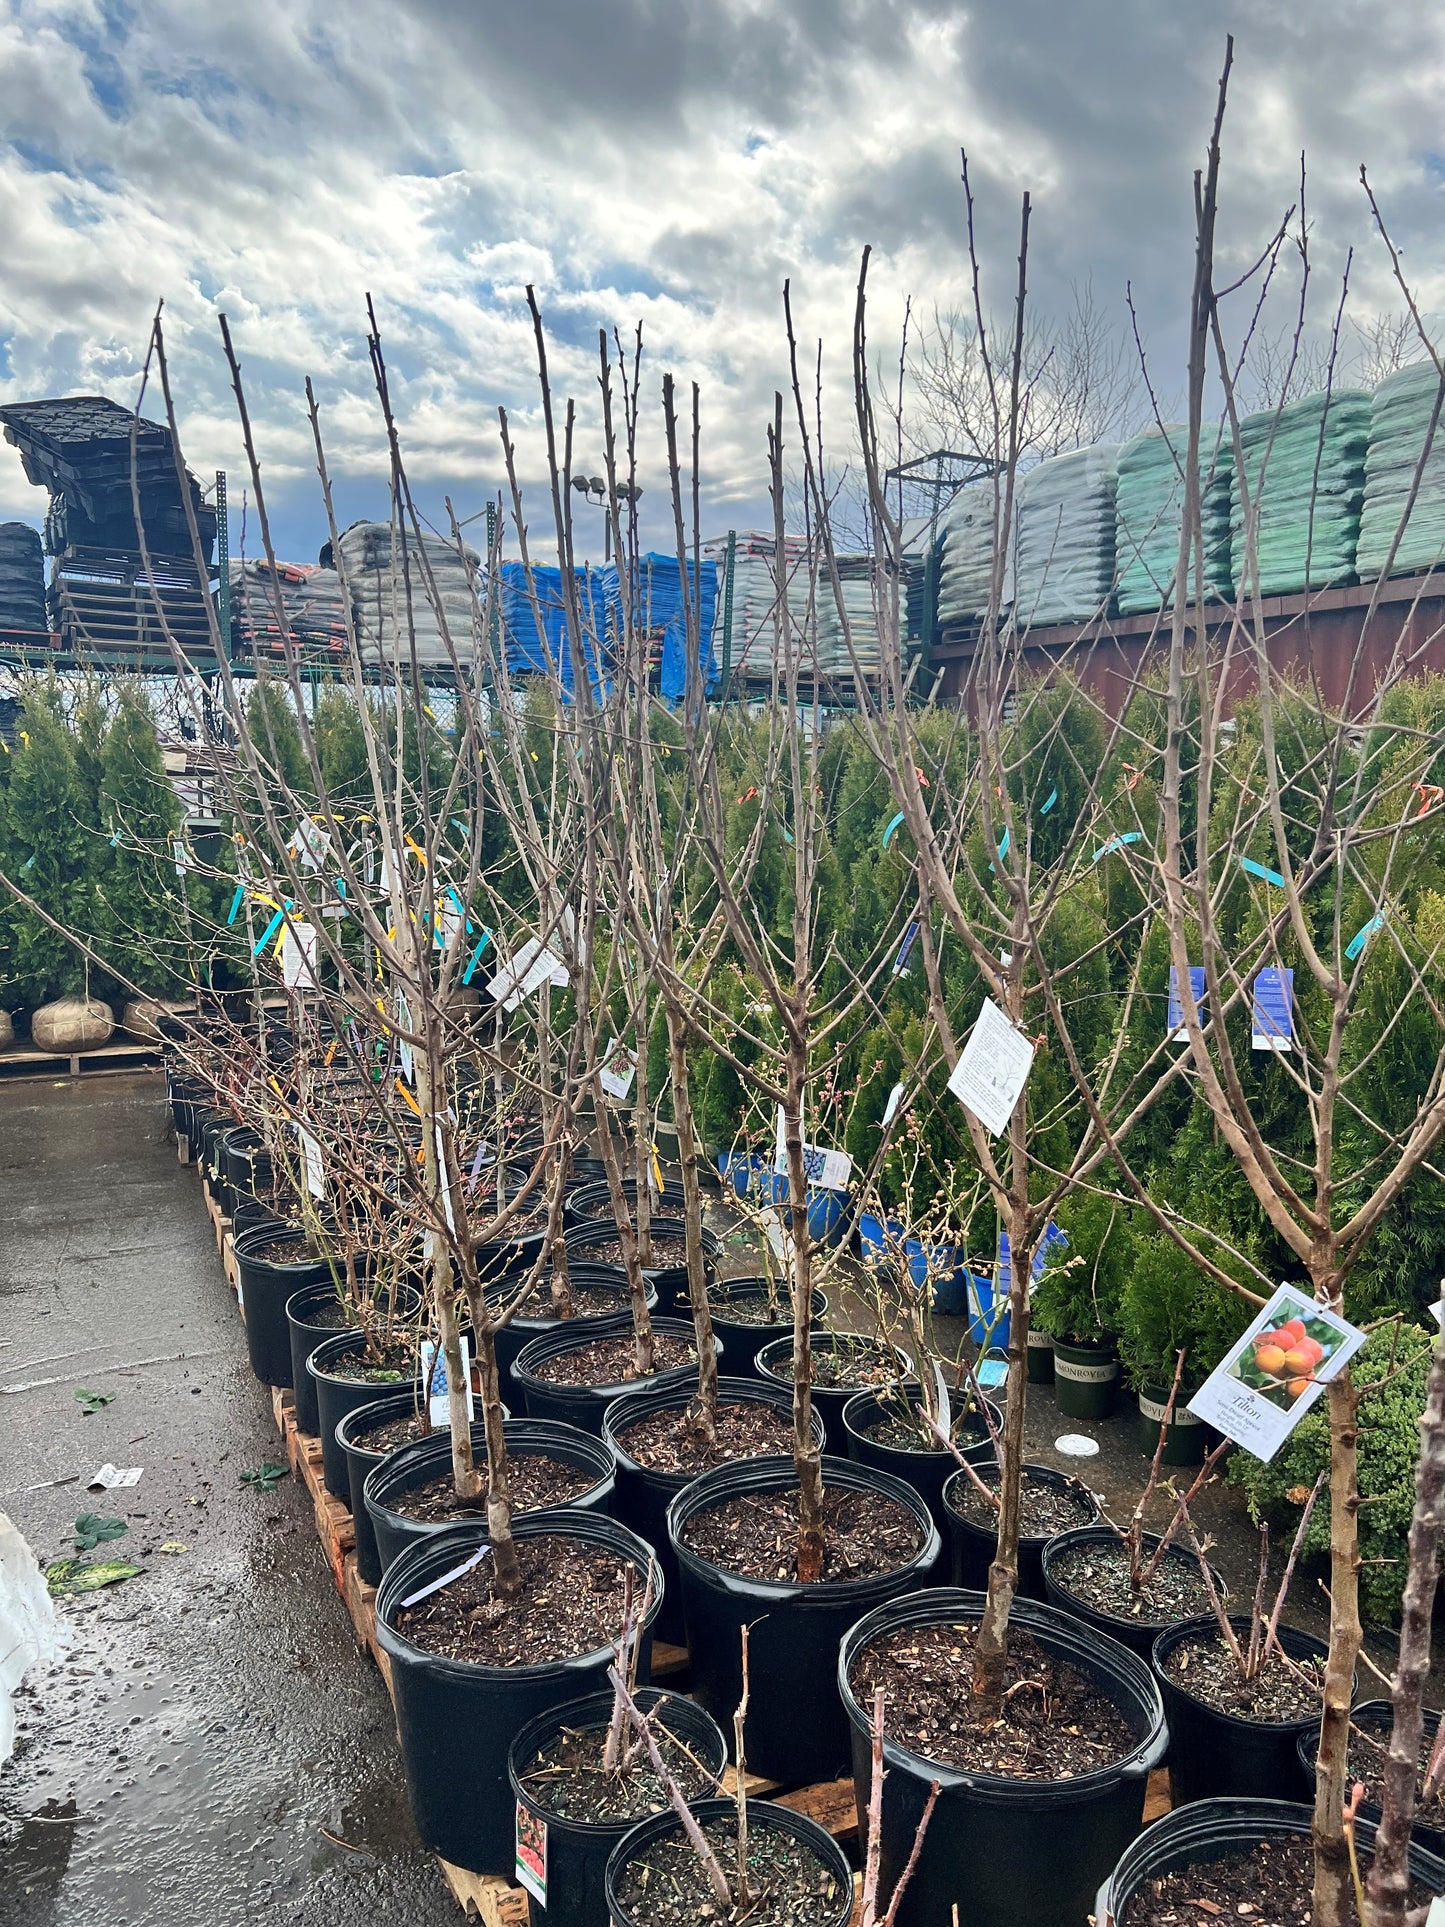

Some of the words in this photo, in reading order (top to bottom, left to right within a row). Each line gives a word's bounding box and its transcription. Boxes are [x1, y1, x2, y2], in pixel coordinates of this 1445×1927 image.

[1029, 1335, 1049, 1344] ROVI
[1059, 1363, 1106, 1378] MONROVIA
[1232, 1395, 1262, 1420] Tilton
